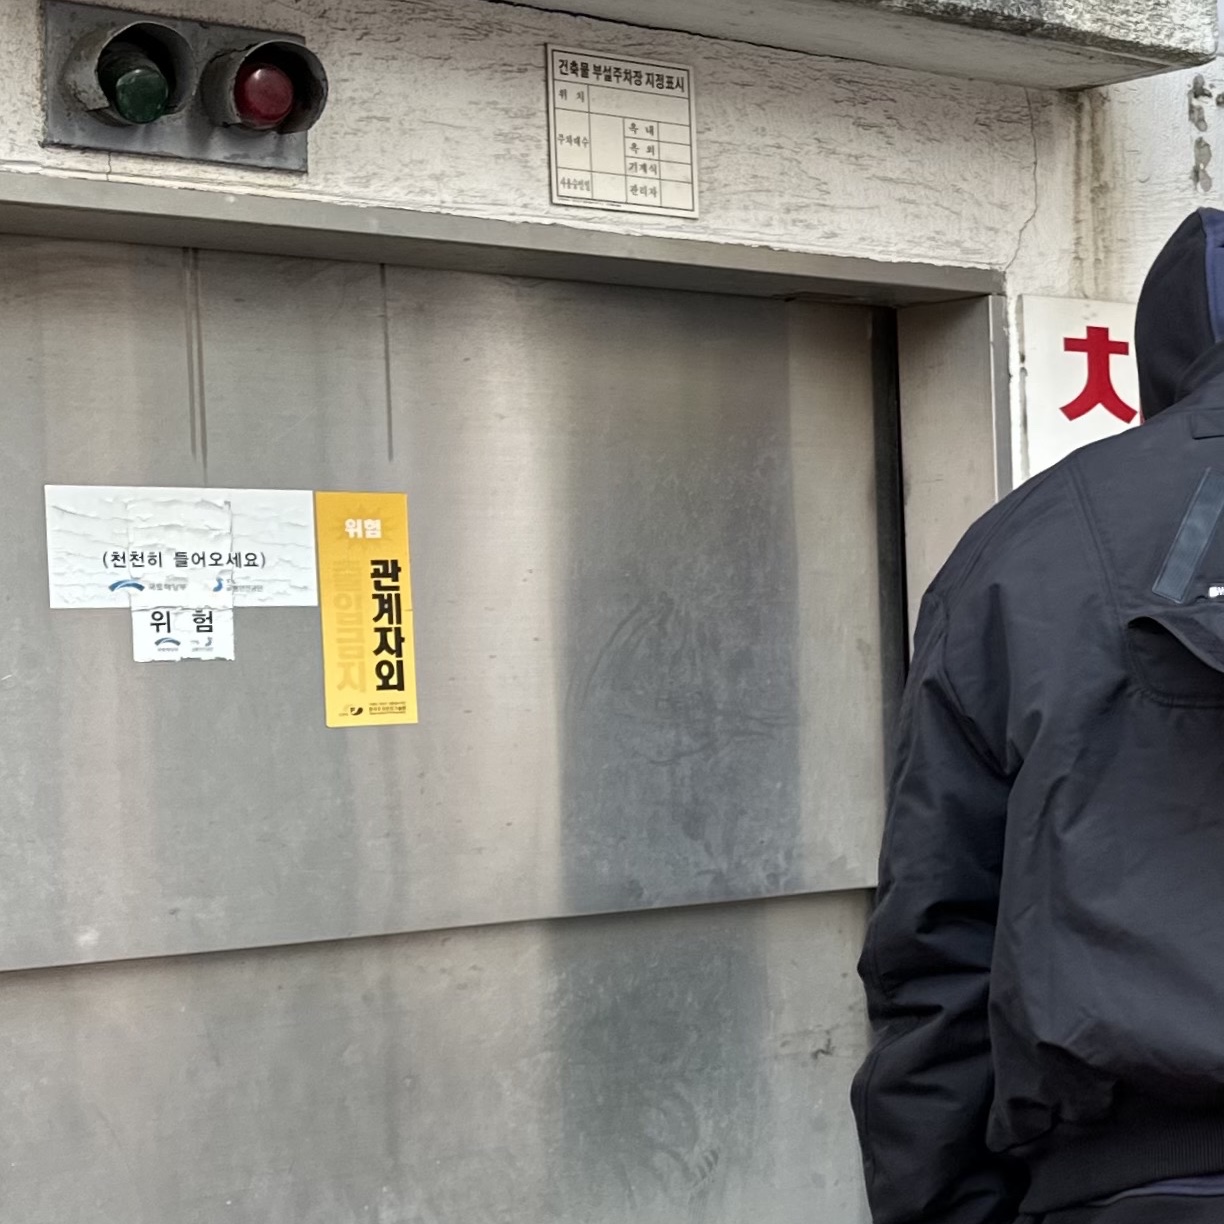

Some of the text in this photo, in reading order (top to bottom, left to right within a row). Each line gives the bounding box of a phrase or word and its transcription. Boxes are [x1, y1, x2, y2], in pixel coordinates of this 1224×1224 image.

[559, 59, 685, 92] 건축물 부설주차장 지정표시
[629, 184, 658, 199] 관리자
[344, 518, 382, 538] 위험
[102, 551, 266, 569] (천천히 들어오세요)
[370, 559, 406, 691] 관계자외
